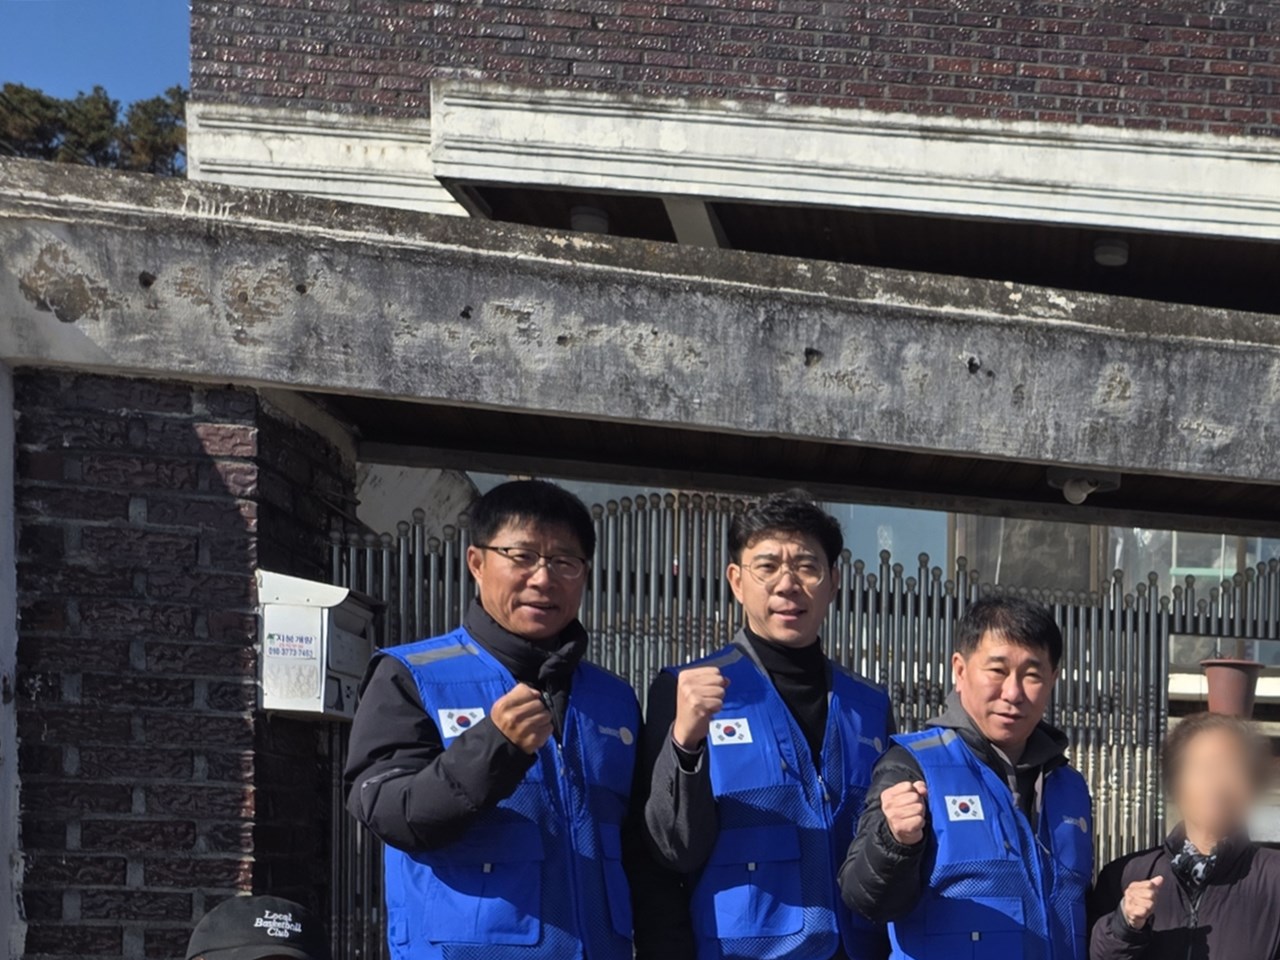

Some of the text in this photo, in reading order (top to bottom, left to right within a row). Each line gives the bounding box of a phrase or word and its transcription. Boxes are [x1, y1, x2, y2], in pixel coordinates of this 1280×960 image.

[264, 910, 292, 921] Local
[254, 918, 302, 933] Basketball
[267, 928, 290, 938] Club
